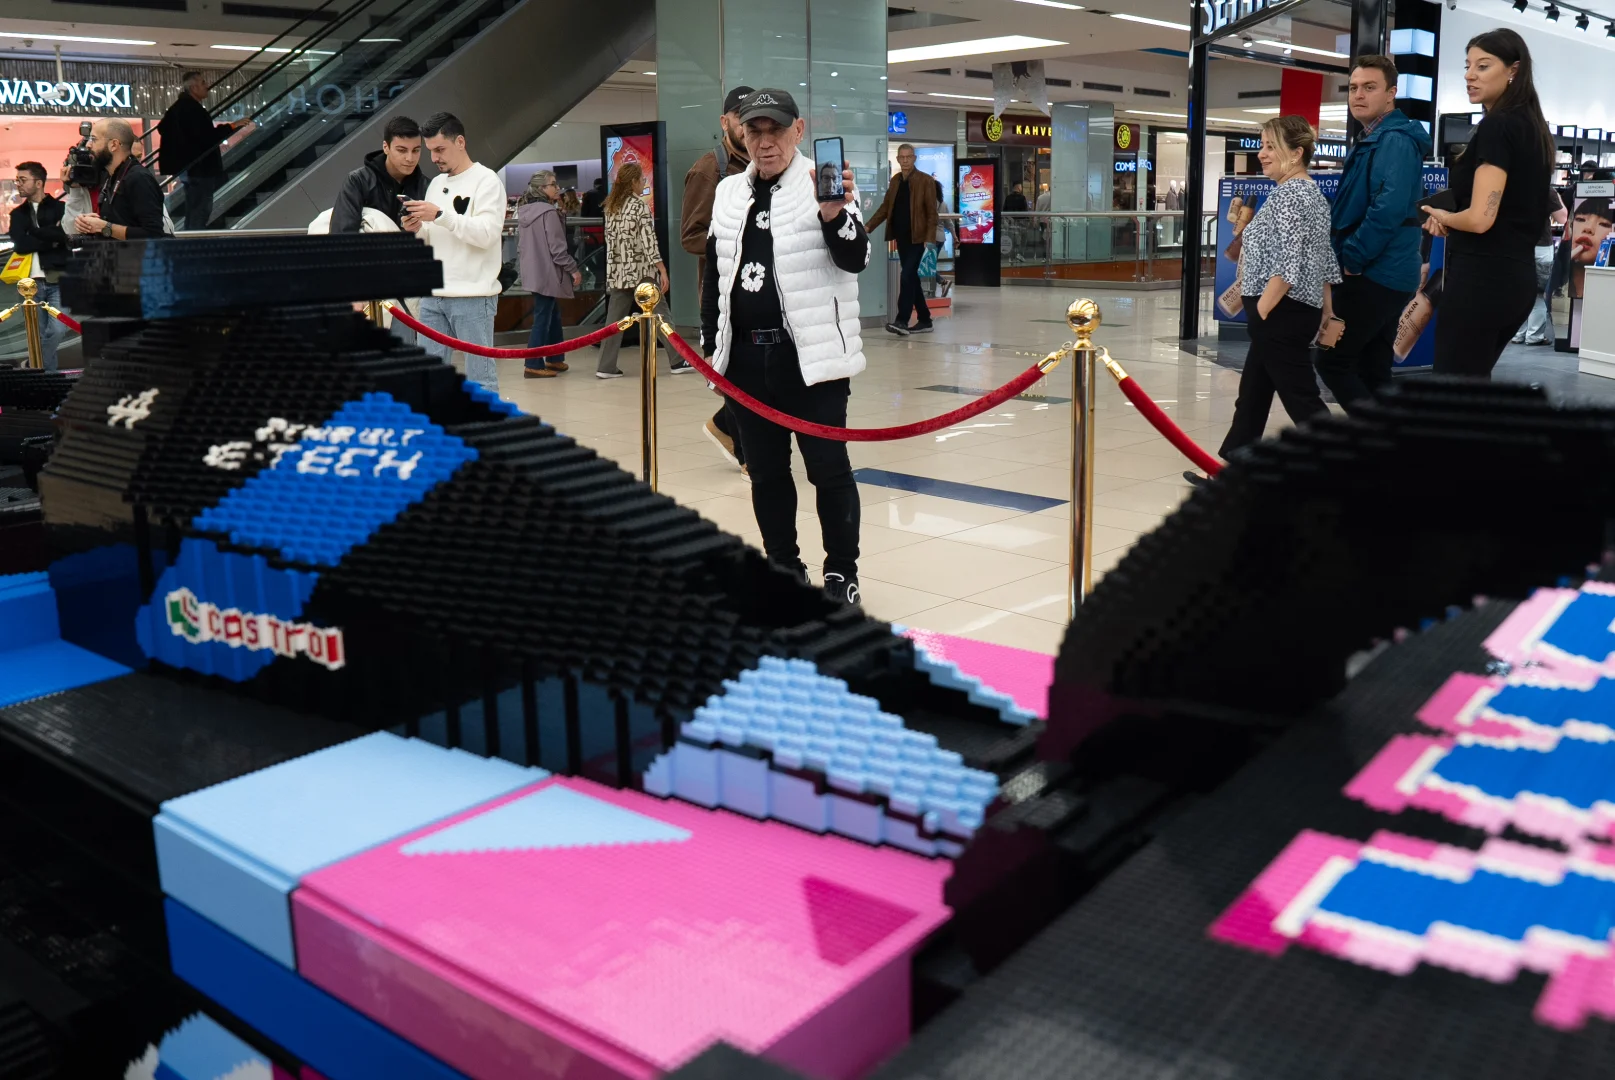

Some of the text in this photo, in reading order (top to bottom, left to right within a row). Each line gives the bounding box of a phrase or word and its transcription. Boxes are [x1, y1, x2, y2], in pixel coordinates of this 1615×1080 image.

[1016, 124, 1052, 137] KAHVE
[1234, 183, 1275, 191] SEPHORA
[1404, 301, 1419, 319] SKIN
[1394, 326, 1409, 347] EVER
